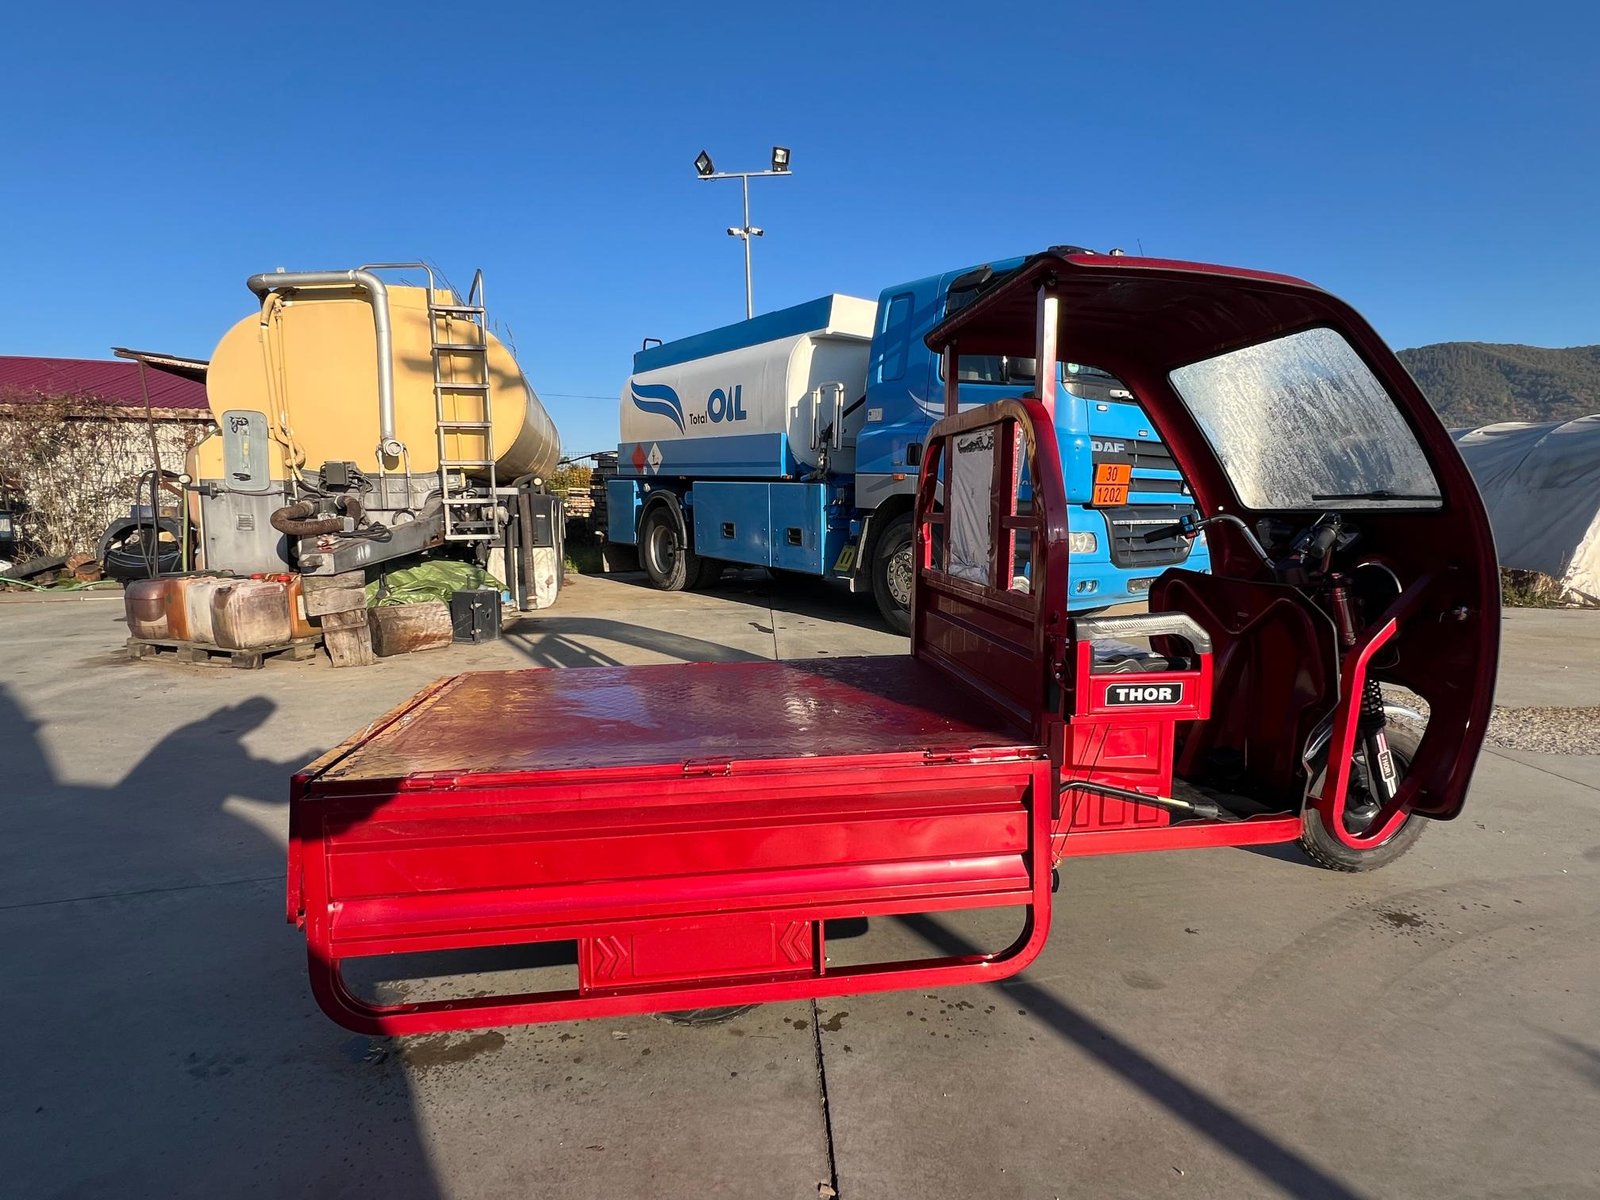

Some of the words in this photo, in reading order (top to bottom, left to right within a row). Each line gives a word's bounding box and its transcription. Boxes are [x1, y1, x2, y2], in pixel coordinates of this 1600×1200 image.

[689, 410, 708, 425] Total
[707, 384, 747, 424] OIL
[1091, 440, 1125, 453] DAF
[1106, 466, 1118, 482] 30
[1098, 487, 1121, 503] 1202
[1116, 687, 1172, 702] THOR
